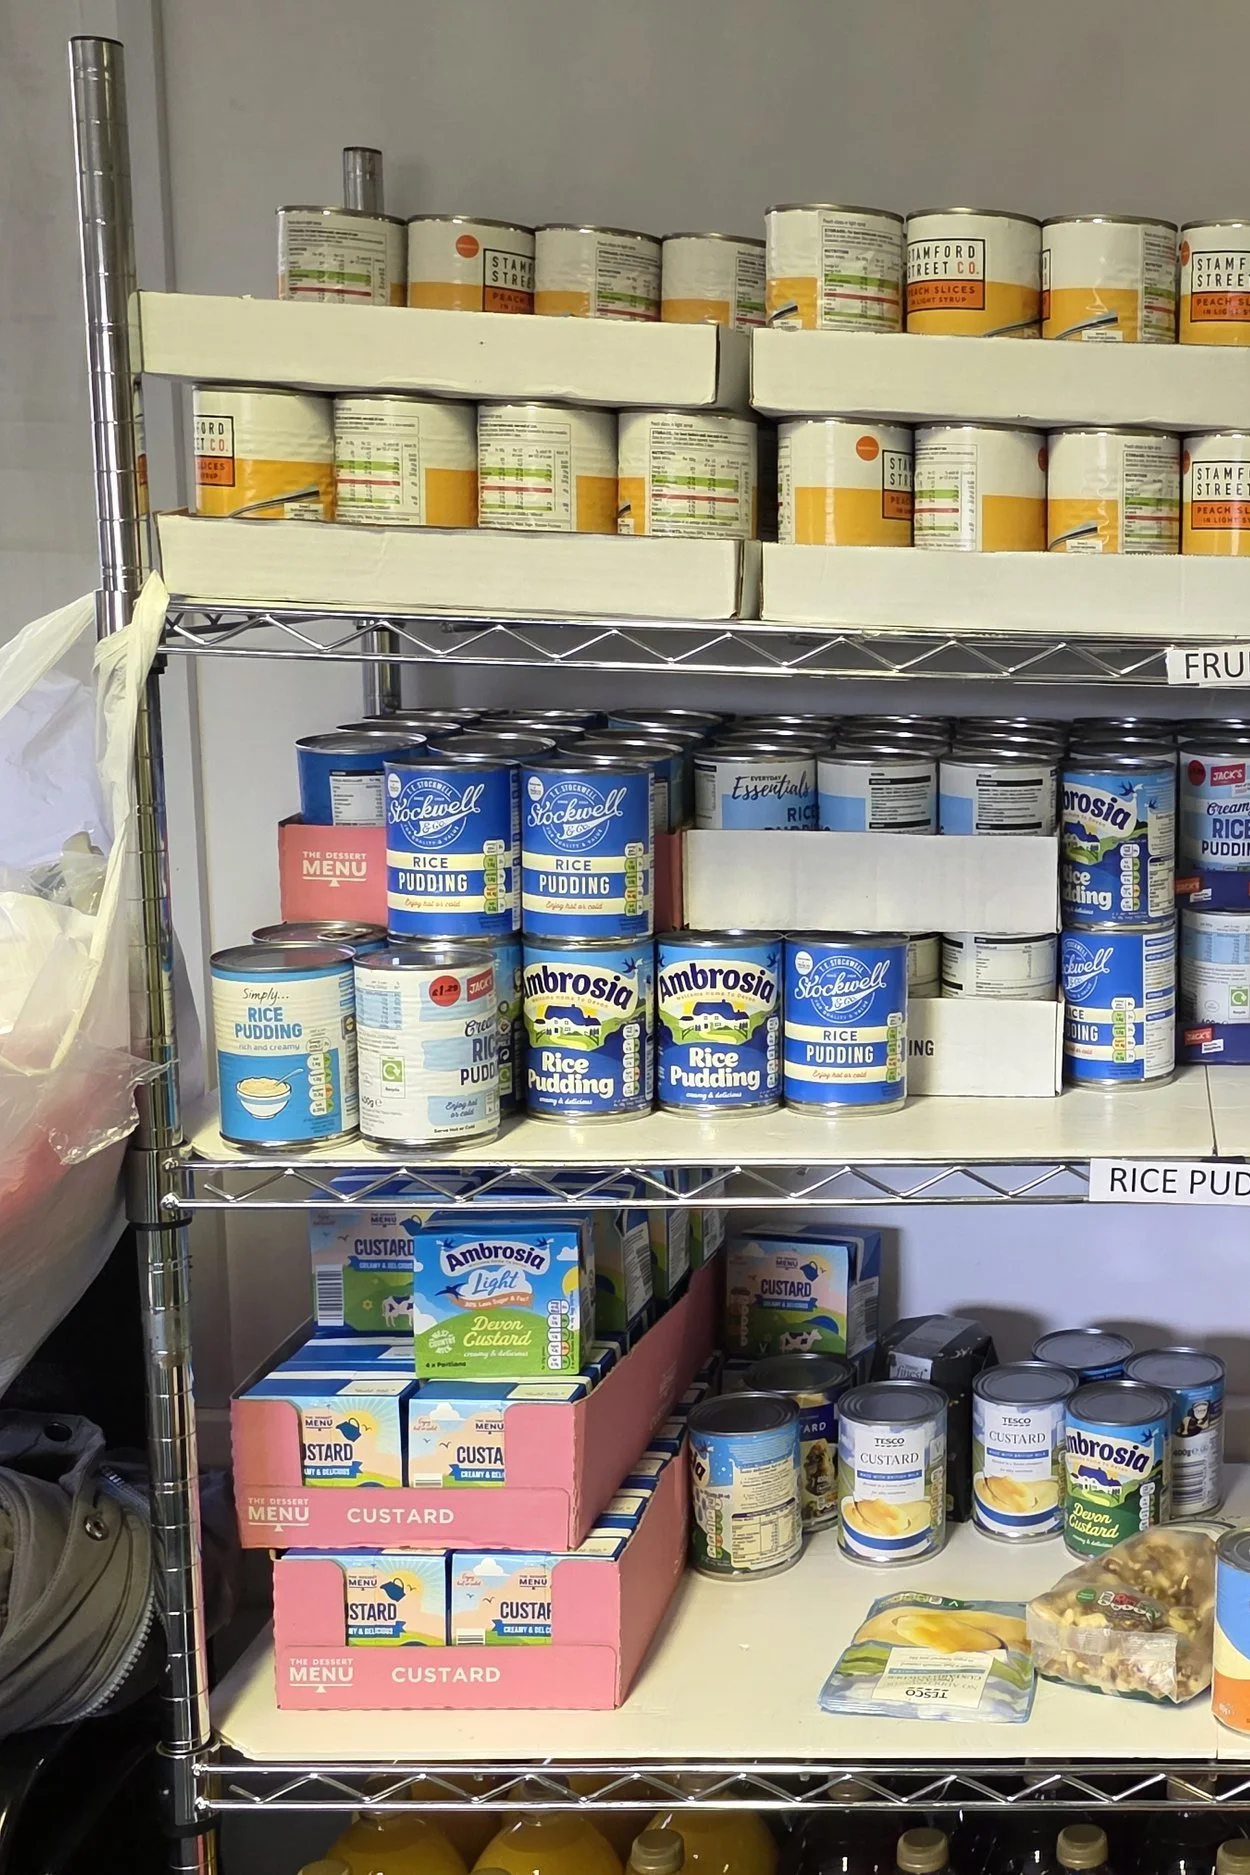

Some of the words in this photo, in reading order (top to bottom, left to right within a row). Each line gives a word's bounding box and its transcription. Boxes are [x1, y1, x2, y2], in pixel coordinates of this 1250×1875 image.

[957, 261, 980, 275] CO.
[934, 284, 977, 295] SLICES
[1196, 298, 1234, 307] PEACH
[1197, 506, 1232, 514] PEACH
[732, 770, 811, 801] Essentials
[388, 783, 485, 825] Stockwell
[527, 787, 628, 828] Stockwell
[302, 851, 321, 859] THE
[325, 851, 367, 860] DESSERT
[412, 857, 449, 870] RICE
[302, 860, 368, 877] MENU
[555, 859, 592, 871] RICE
[398, 871, 468, 893] PUDDING
[539, 874, 610, 895] PUDDING
[443, 900, 461, 908] cold
[588, 901, 603, 910] cold
[658, 962, 776, 1004] Ambrosia
[794, 959, 891, 1000] Stockwell
[242, 987, 290, 1006] Simply...
[247, 1007, 283, 1023] RICE
[235, 1023, 302, 1040] PUDDING
[823, 1030, 858, 1042] RICE
[541, 1051, 590, 1074] Rice
[689, 1046, 739, 1068] Rice
[806, 1045, 874, 1064] PUDDING
[670, 1065, 761, 1091] Pudding
[811, 1068, 831, 1079] Enjoy
[527, 1068, 614, 1099] Pudding
[1109, 1167, 1178, 1194] RICE
[371, 1215, 397, 1224] MENU
[354, 1238, 414, 1256] CUSTARD
[446, 1242, 547, 1272] Ambrosia
[776, 1260, 798, 1268] MENU
[471, 1266, 519, 1296] Light
[761, 1278, 812, 1298] CUSTARD
[470, 1315, 524, 1332] Devon
[462, 1330, 533, 1347] Custard
[304, 1419, 334, 1427] MENU
[475, 1422, 504, 1430] MENU
[1001, 1416, 1032, 1427] TESCO
[874, 1437, 905, 1448] TESCO
[989, 1430, 1046, 1445] CUSTARD
[860, 1452, 919, 1466] CUSTARD
[460, 1470, 485, 1479] CREAMY
[248, 1507, 310, 1522] MENU
[347, 1508, 455, 1524] CUSTARD
[1072, 1502, 1112, 1525] Devon
[1069, 1514, 1119, 1539] Custard
[348, 1578, 377, 1587] MENU
[519, 1578, 548, 1586] MENU
[503, 1626, 526, 1634] CREAMY
[289, 1667, 354, 1682] MENU
[391, 1667, 501, 1683] CUSTARD
[905, 1687, 949, 1699] TESCO
